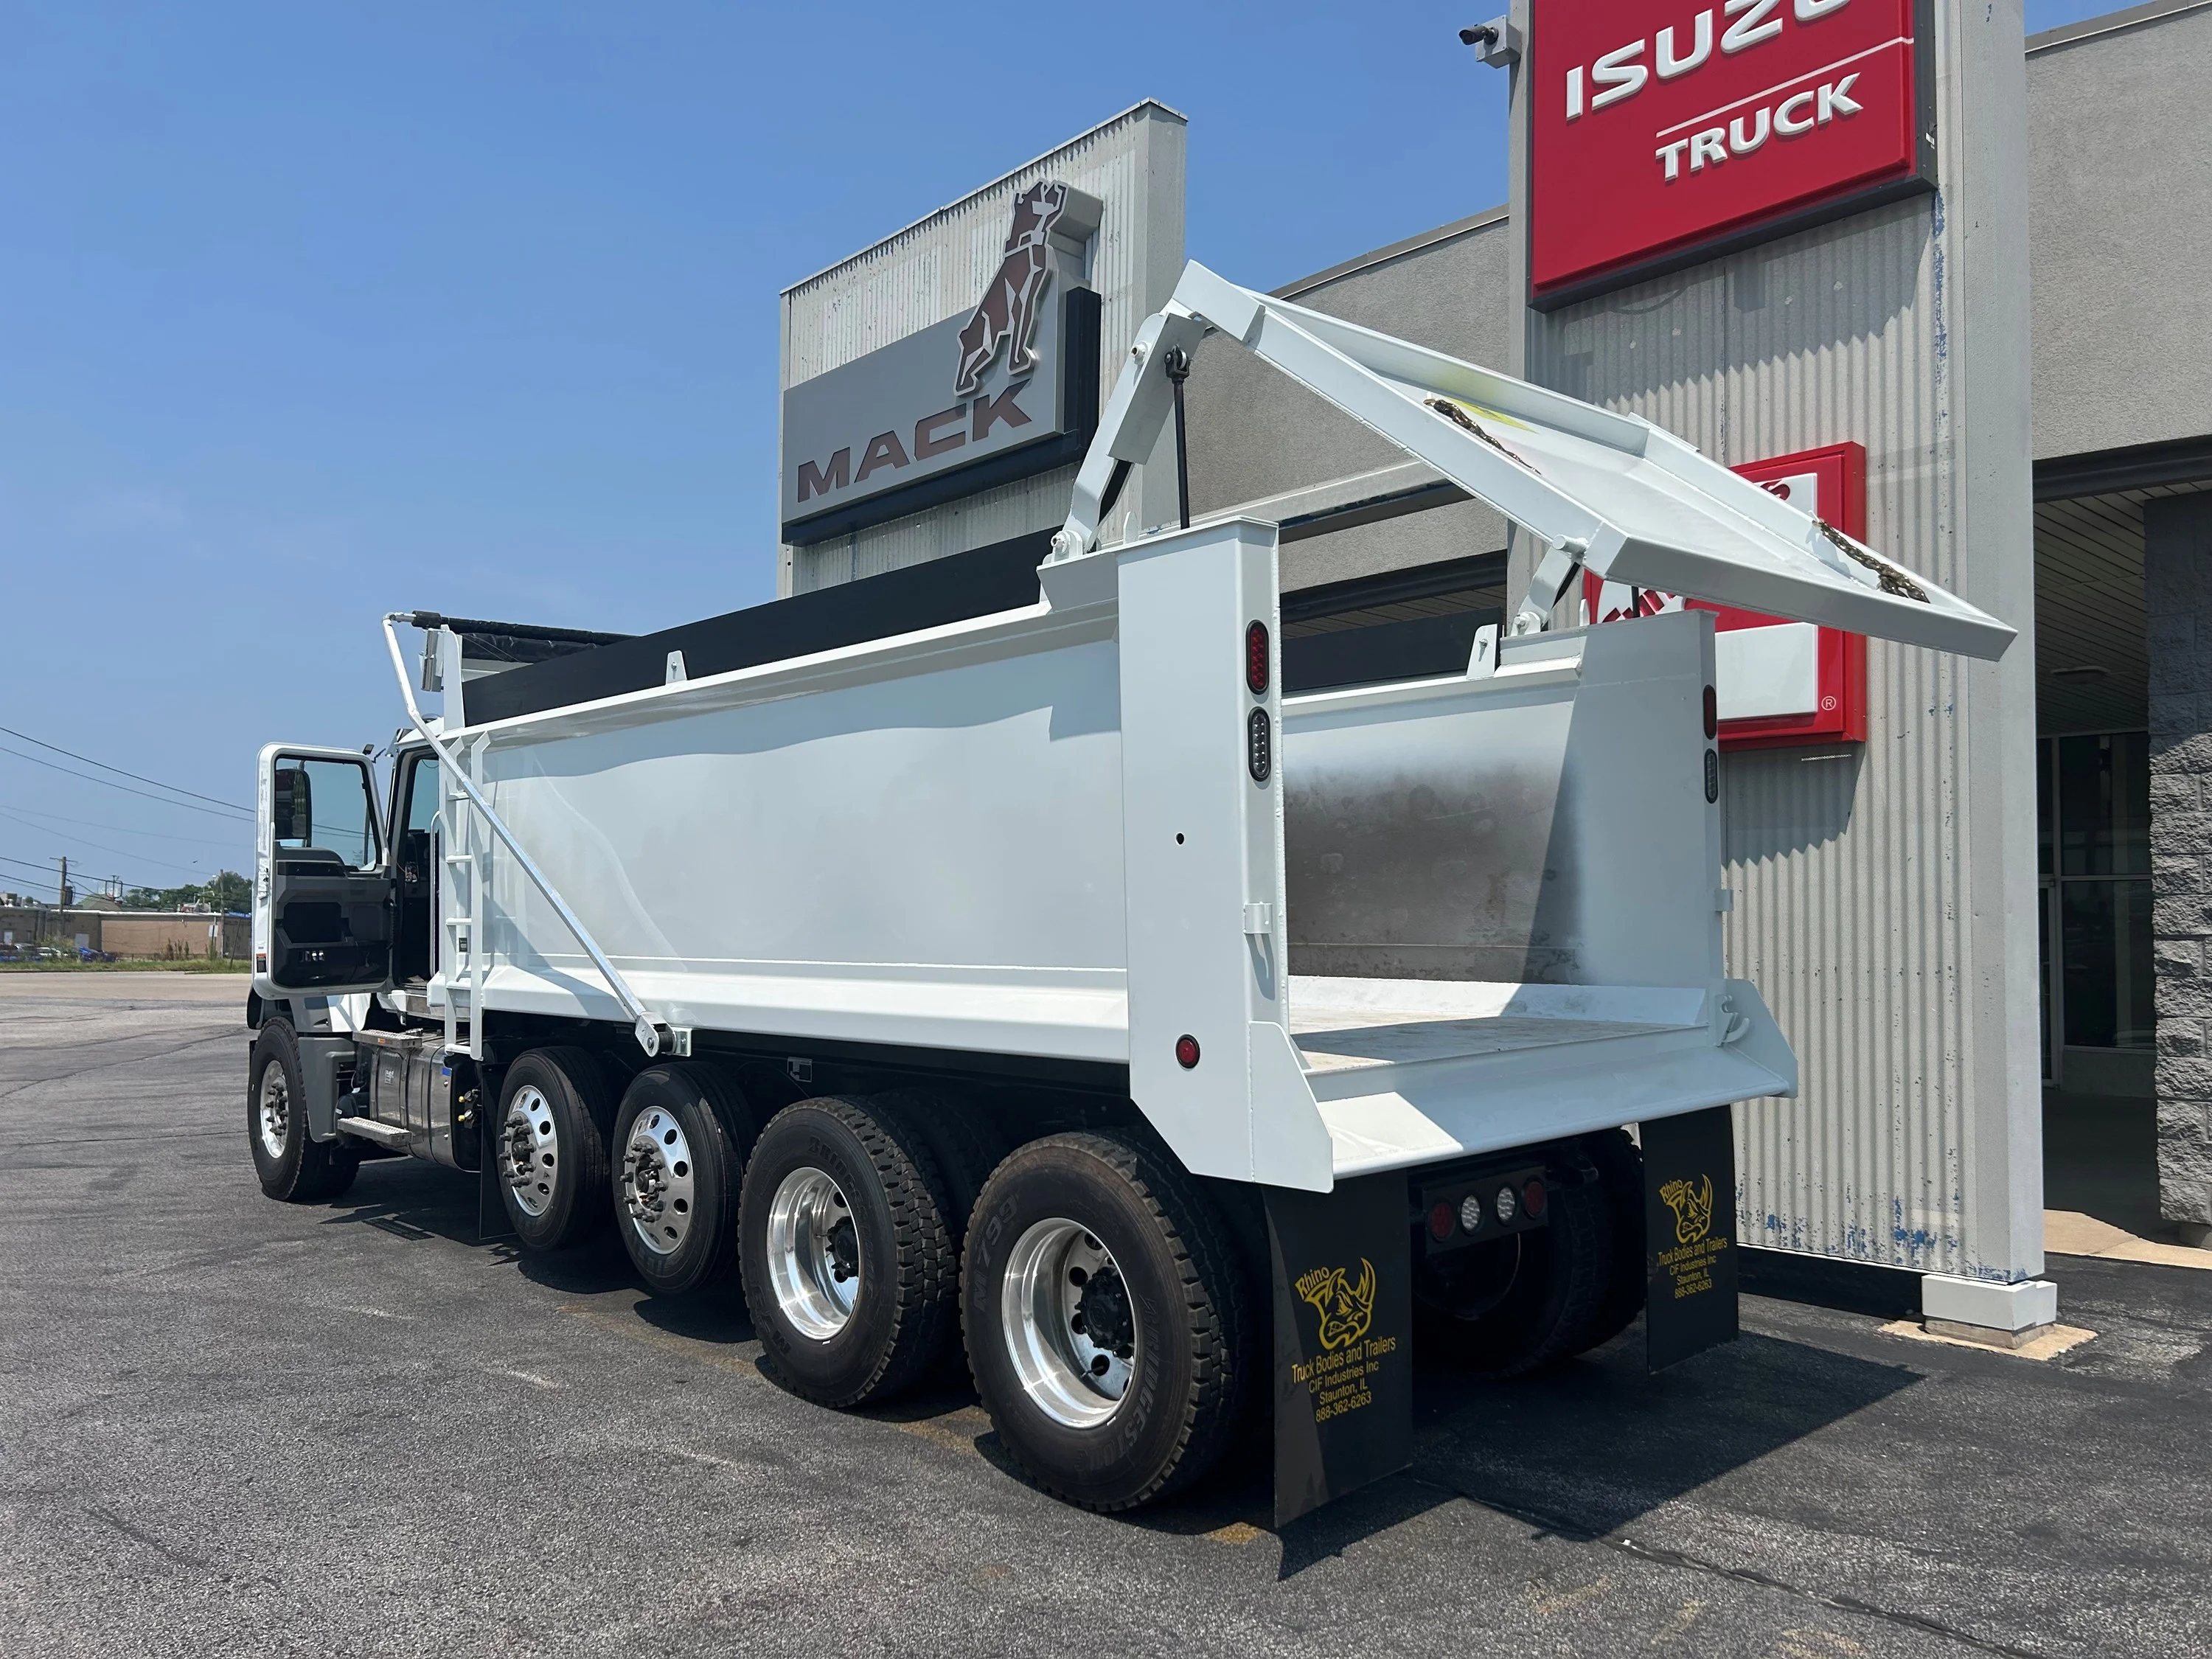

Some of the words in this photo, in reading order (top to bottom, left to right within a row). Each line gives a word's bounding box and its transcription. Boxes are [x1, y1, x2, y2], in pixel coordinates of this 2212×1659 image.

[1656, 72, 1863, 181] TRUCK
[798, 378, 1032, 503] MACK
[1659, 1179, 1683, 1203] Rhino
[1658, 1249, 1674, 1266] Truck
[1674, 1245, 1693, 1262] Bodies
[1694, 1239, 1705, 1256] and
[1705, 1237, 1728, 1252] Trailers
[1669, 1263, 1679, 1276] CIF
[1680, 1257, 1707, 1272] Industries
[1707, 1254, 1717, 1265] Inc
[1295, 1267, 1330, 1301] Rhino
[1703, 1267, 1710, 1278] IL
[1674, 1278, 1712, 1299] 888-362-6263
[1292, 1359, 1315, 1383] Truck
[1316, 1350, 1344, 1374] Bodies
[1346, 1342, 1363, 1363] and
[1364, 1335, 1396, 1358] Trailers
[1309, 1376, 1324, 1394] CIF
[1325, 1365, 1364, 1387] Industries
[1366, 1360, 1380, 1374] Inc
[1319, 1383, 1357, 1405] Staunton,
[1360, 1377, 1369, 1391] IL
[1315, 1391, 1372, 1423] 888-362-6263
